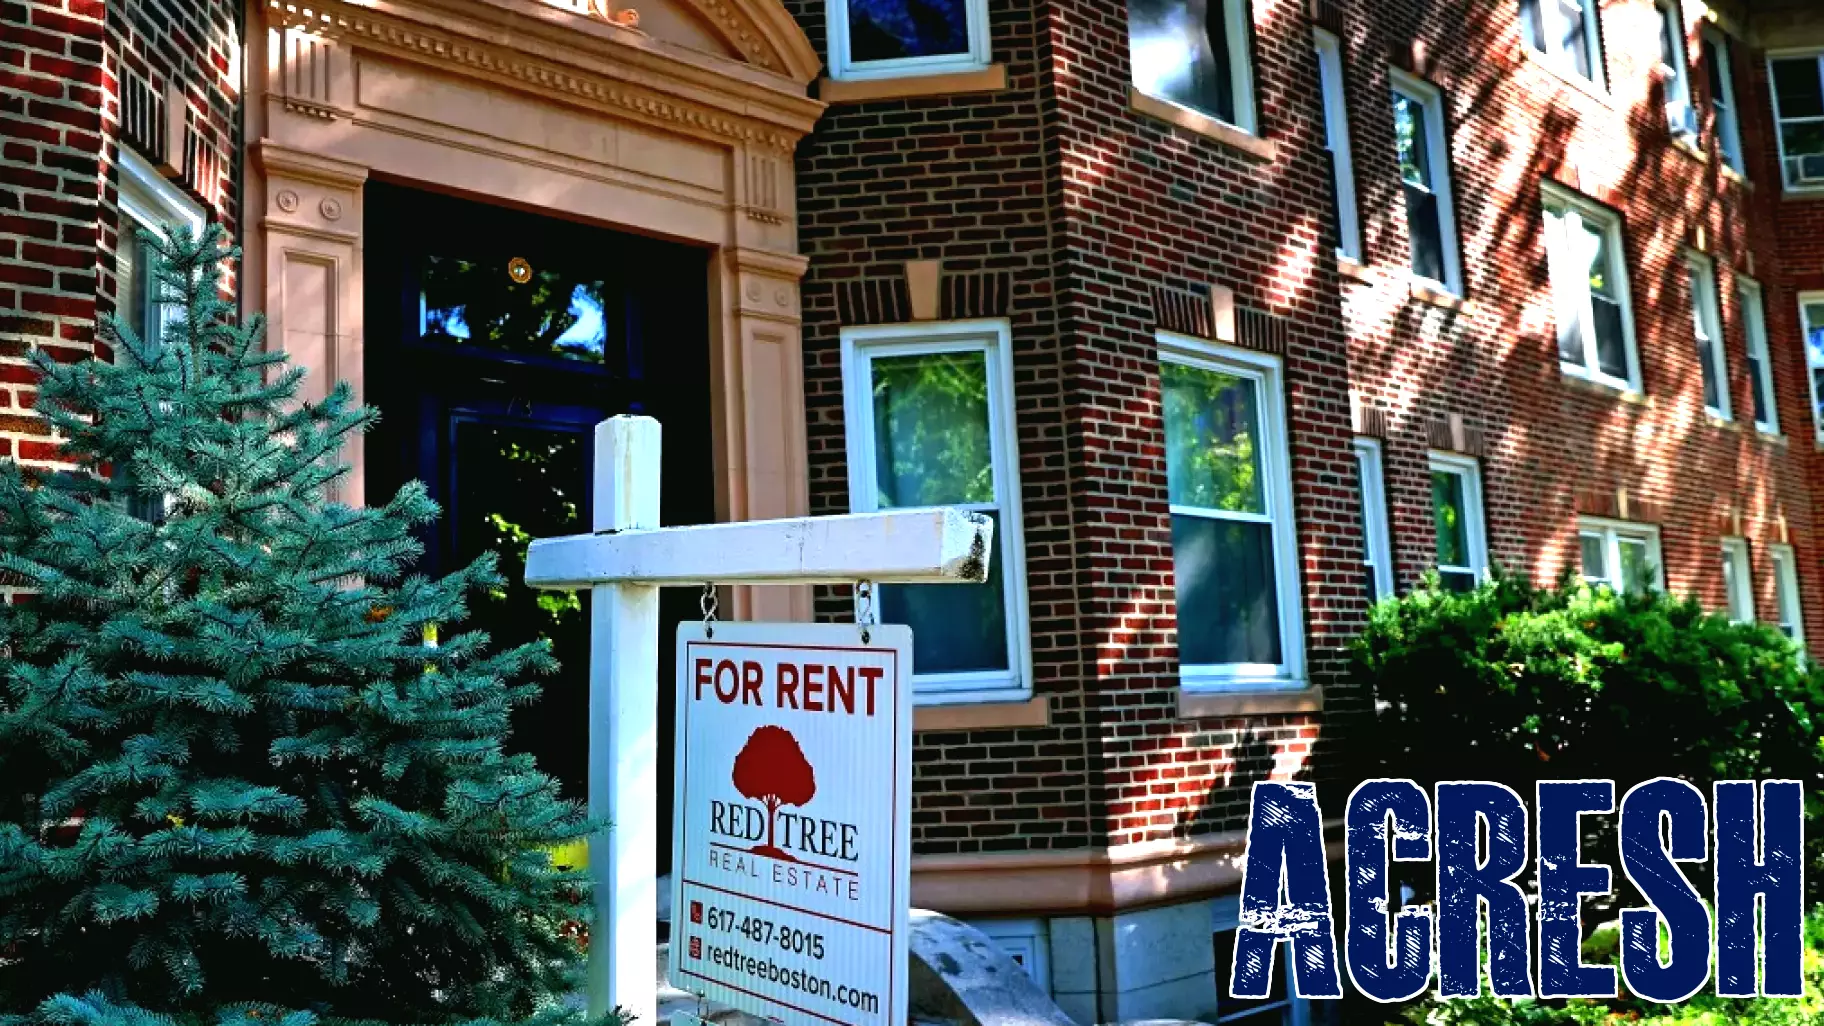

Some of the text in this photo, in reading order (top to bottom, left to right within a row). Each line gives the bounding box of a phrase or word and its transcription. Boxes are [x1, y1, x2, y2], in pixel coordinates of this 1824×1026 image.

[695, 658, 884, 716] FOR RENT
[710, 800, 859, 862] RED TREE
[709, 850, 859, 900] REAL ESTATE
[708, 907, 825, 960] 617-487-8015
[707, 942, 879, 1014] redtreeboston.com
